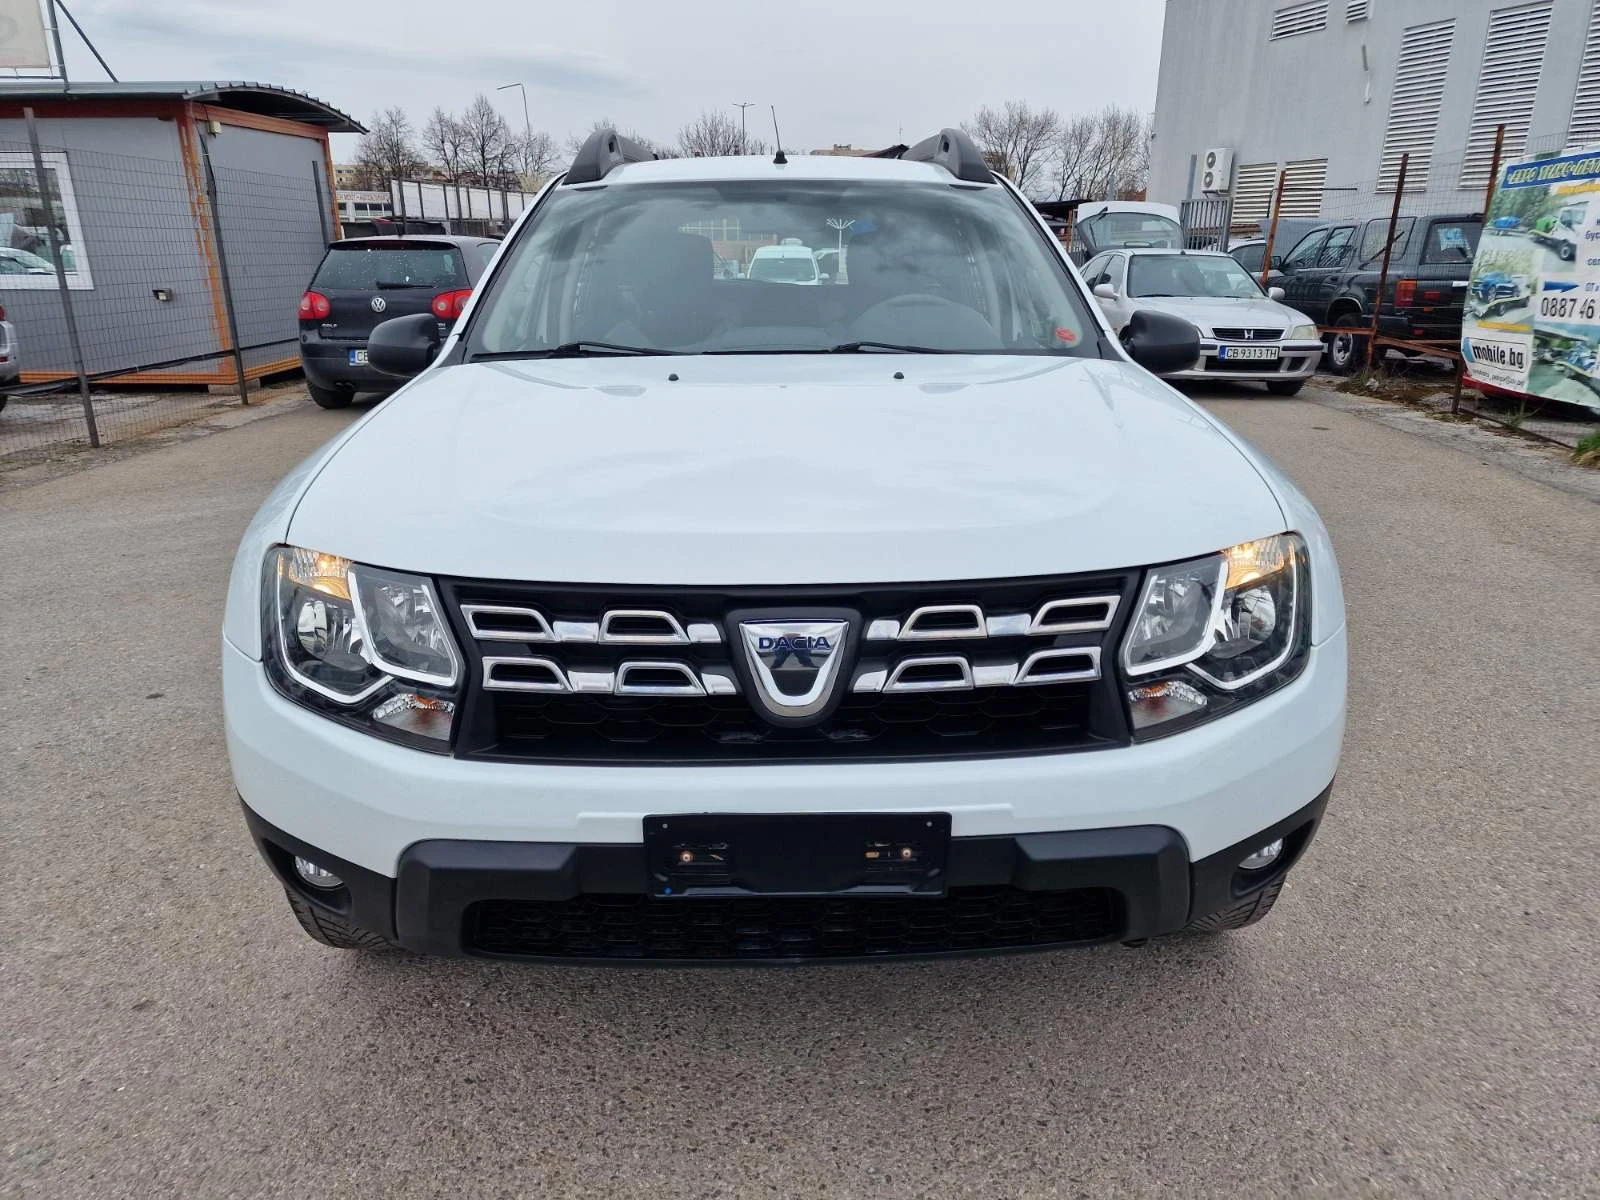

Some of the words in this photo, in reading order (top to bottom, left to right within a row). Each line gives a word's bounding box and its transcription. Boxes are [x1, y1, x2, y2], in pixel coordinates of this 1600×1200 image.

[1541, 297, 1578, 318] 0887
[1579, 298, 1596, 319] 46
[1240, 349, 1263, 358] 9313
[758, 635, 831, 650] DACIA
